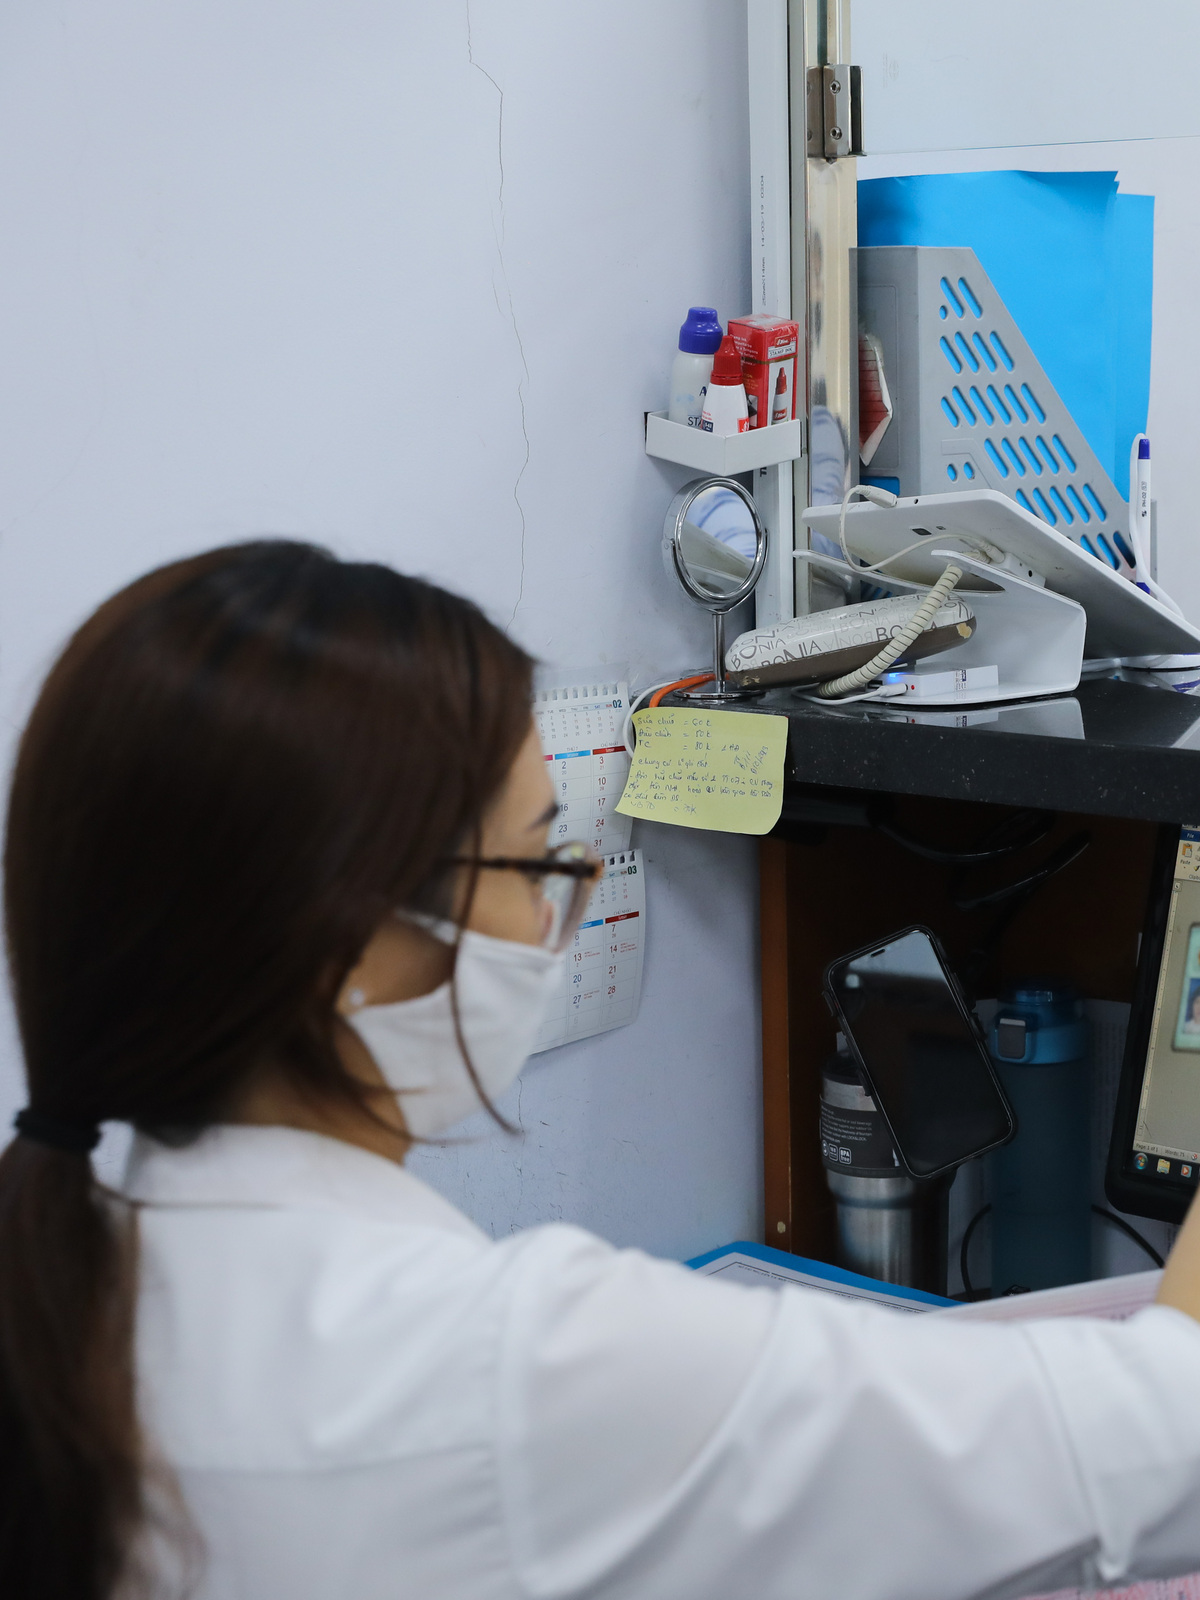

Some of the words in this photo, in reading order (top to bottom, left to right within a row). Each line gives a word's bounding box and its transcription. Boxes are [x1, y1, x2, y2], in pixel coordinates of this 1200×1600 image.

[731, 638, 786, 670] BONIA
[613, 700, 622, 708] 02
[600, 756, 604, 764] 3
[562, 761, 566, 769] 2
[598, 777, 606, 785] 10
[598, 798, 605, 806] 17
[596, 819, 604, 827] 24
[558, 825, 567, 833] 23
[594, 839, 602, 847] 31
[627, 865, 637, 875] 03
[612, 924, 616, 932] 7
[610, 945, 617, 953] 14
[574, 953, 582, 962] 13
[609, 966, 616, 974] 21
[573, 974, 582, 983] 20
[608, 986, 616, 994] 28
[573, 995, 581, 1004] 27
[840, 1149, 850, 1157] BPA
